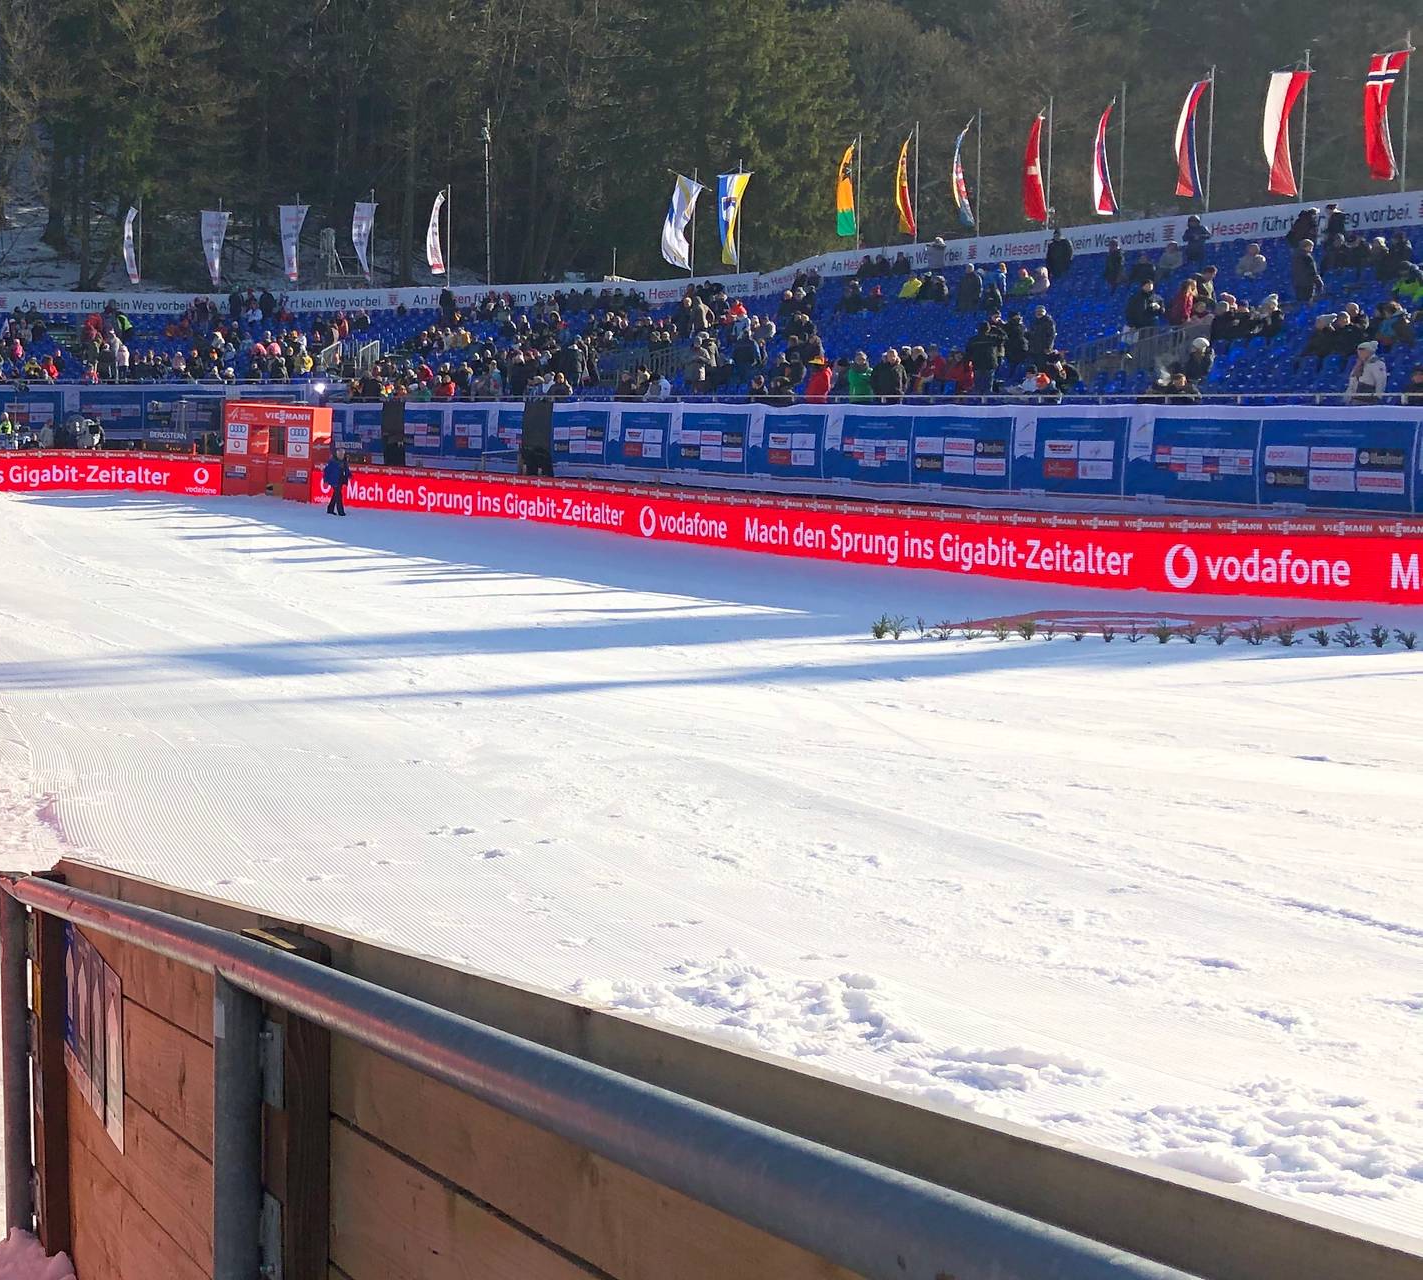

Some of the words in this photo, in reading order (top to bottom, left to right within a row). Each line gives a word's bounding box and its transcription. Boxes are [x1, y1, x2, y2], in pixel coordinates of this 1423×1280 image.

[1211, 220, 1258, 235] Hessen
[989, 245, 1002, 258] An
[1005, 243, 1041, 256] Hessen
[844, 259, 863, 271] Hes
[916, 251, 928, 264] We
[39, 299, 77, 310] Hessen
[132, 299, 155, 312] Weg
[301, 298, 322, 308] kein
[325, 297, 347, 310] Weg
[414, 294, 428, 305] An
[264, 410, 311, 424] VIESSMANN
[9, 464, 171, 488] Gigabit-Zeitalter
[185, 485, 217, 495] vodafone
[347, 478, 383, 502] Mach
[387, 483, 414, 505] den
[418, 485, 473, 516] Sprung
[477, 491, 501, 513] ins
[503, 492, 625, 527] Gigabit-Zeitalter
[658, 508, 728, 539] vodafone
[965, 511, 999, 524] VIESSMANN
[1002, 513, 1037, 525] VIESSMANN
[1041, 515, 1077, 527] VIESSMANN
[1081, 516, 1120, 530] VIESSMANN
[1124, 518, 1165, 531] VIESSMANN
[1169, 519, 1212, 532] VIESSMANN
[1217, 520, 1263, 534] VIESSMANN
[1267, 521, 1316, 535] VIESSMANN
[1322, 522, 1373, 536] VIESSMANN
[1378, 522, 1423, 538] VIESSMAN
[744, 517, 789, 545] Mach
[793, 521, 826, 550] den
[830, 524, 899, 564] Sprung
[904, 531, 934, 560] ins
[939, 532, 1134, 577] Gigabit-Zeitalter
[1205, 548, 1351, 587] vodafone
